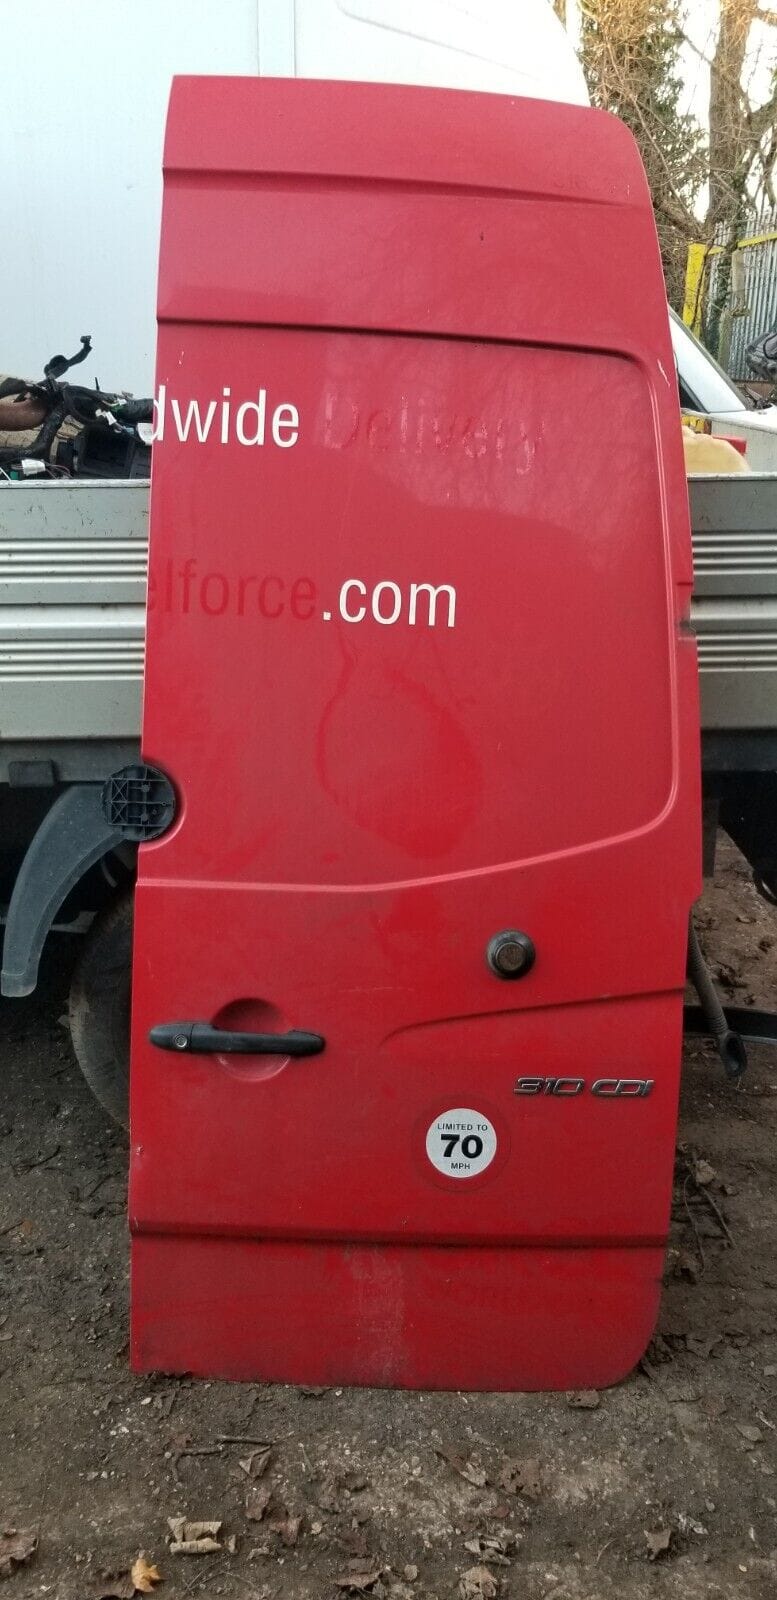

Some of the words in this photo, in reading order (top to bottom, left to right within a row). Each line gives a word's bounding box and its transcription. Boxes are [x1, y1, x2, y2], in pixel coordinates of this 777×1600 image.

[514, 1077, 585, 1095] 310
[591, 1078, 655, 1096] CDI
[437, 1123, 473, 1131] LIMITED
[441, 1133, 483, 1159] 70
[451, 1162, 471, 1170] MPH
